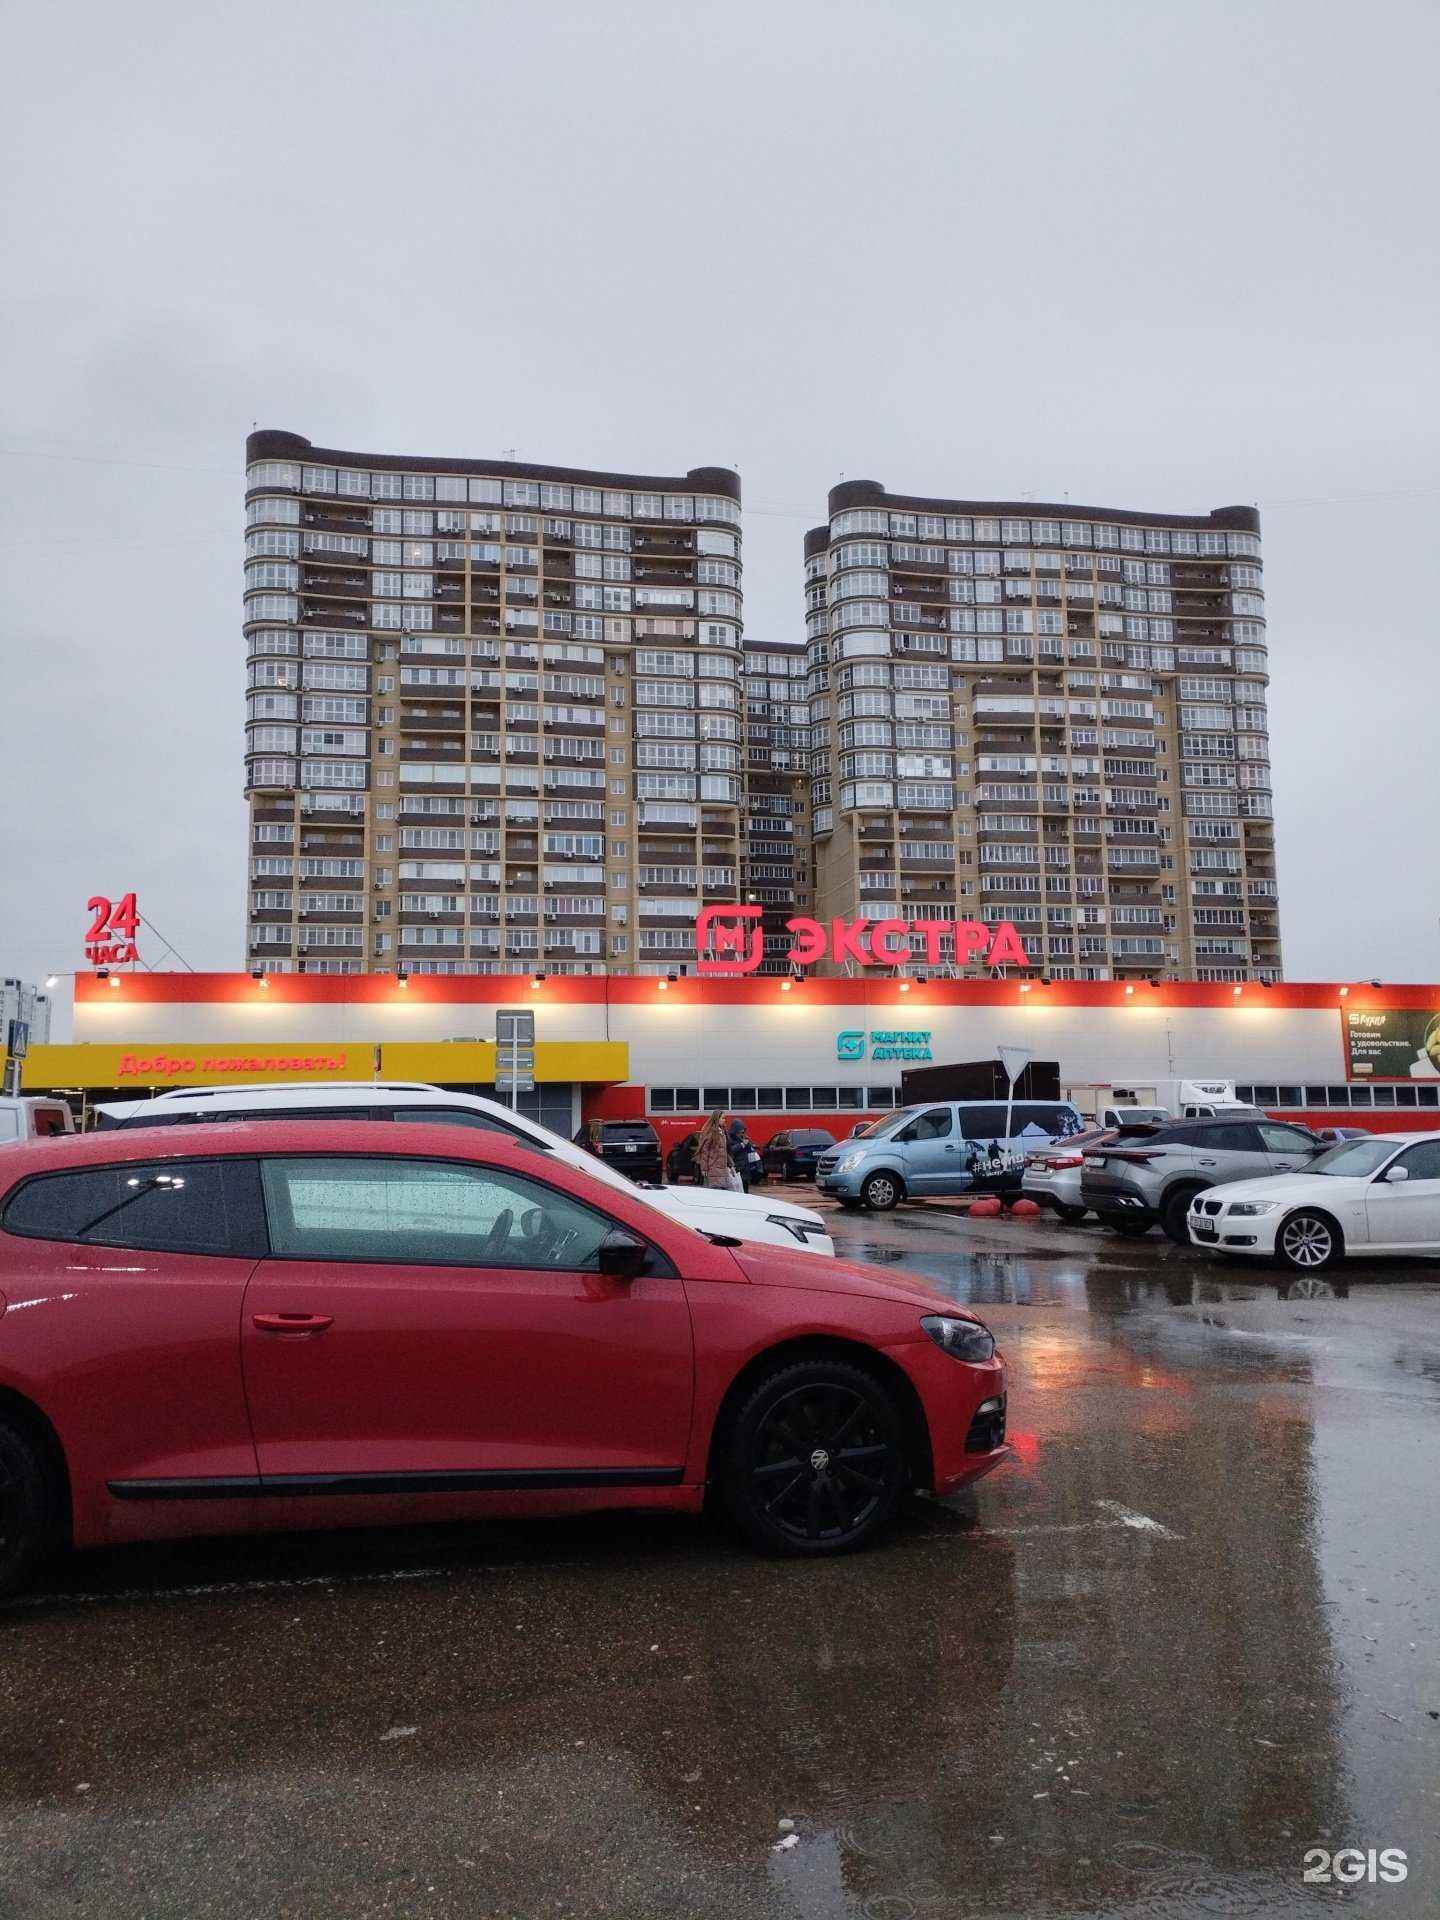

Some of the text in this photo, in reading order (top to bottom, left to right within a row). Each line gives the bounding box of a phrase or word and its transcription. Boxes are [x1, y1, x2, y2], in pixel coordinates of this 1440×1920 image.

[85, 893, 140, 942] 24
[785, 918, 1031, 967] ЭКСТРА
[85, 943, 140, 965] ЧАСА
[871, 1031, 931, 1043] МАГНИТ
[1350, 1030, 1381, 1038] Готовим
[872, 1048, 933, 1060] АПТЕКА
[1352, 1048, 1367, 1056] Для
[119, 1051, 346, 1076] Добро пожаловать!
